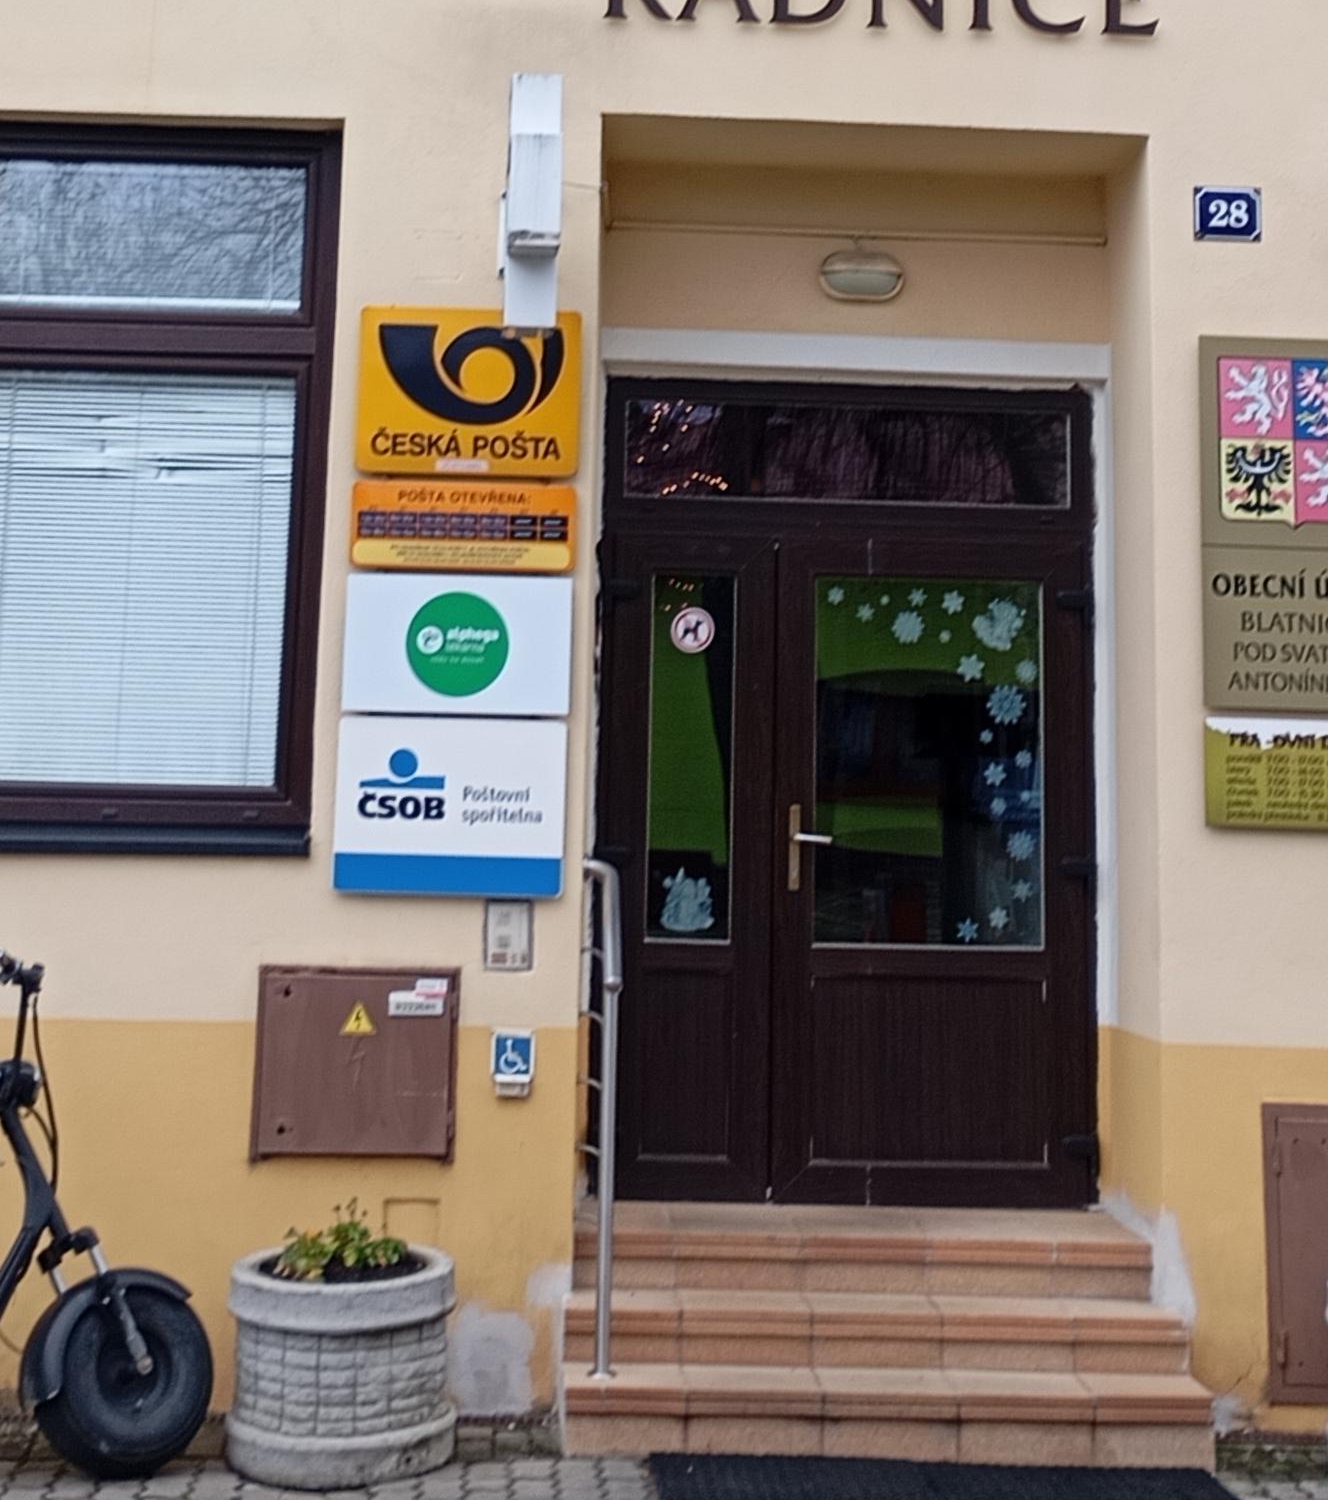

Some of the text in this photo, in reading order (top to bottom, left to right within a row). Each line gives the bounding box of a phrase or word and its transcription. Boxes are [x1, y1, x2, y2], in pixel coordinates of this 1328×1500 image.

[1207, 199, 1249, 229] 28
[371, 427, 560, 462] ČESKÁ POŠTA
[398, 487, 445, 504] POŠTA
[1212, 567, 1306, 600] OBECNÍ
[1233, 640, 1275, 663] POD
[358, 790, 445, 820] ČSOB
[462, 784, 531, 804] Poštovní
[462, 805, 542, 827] spořitelna
